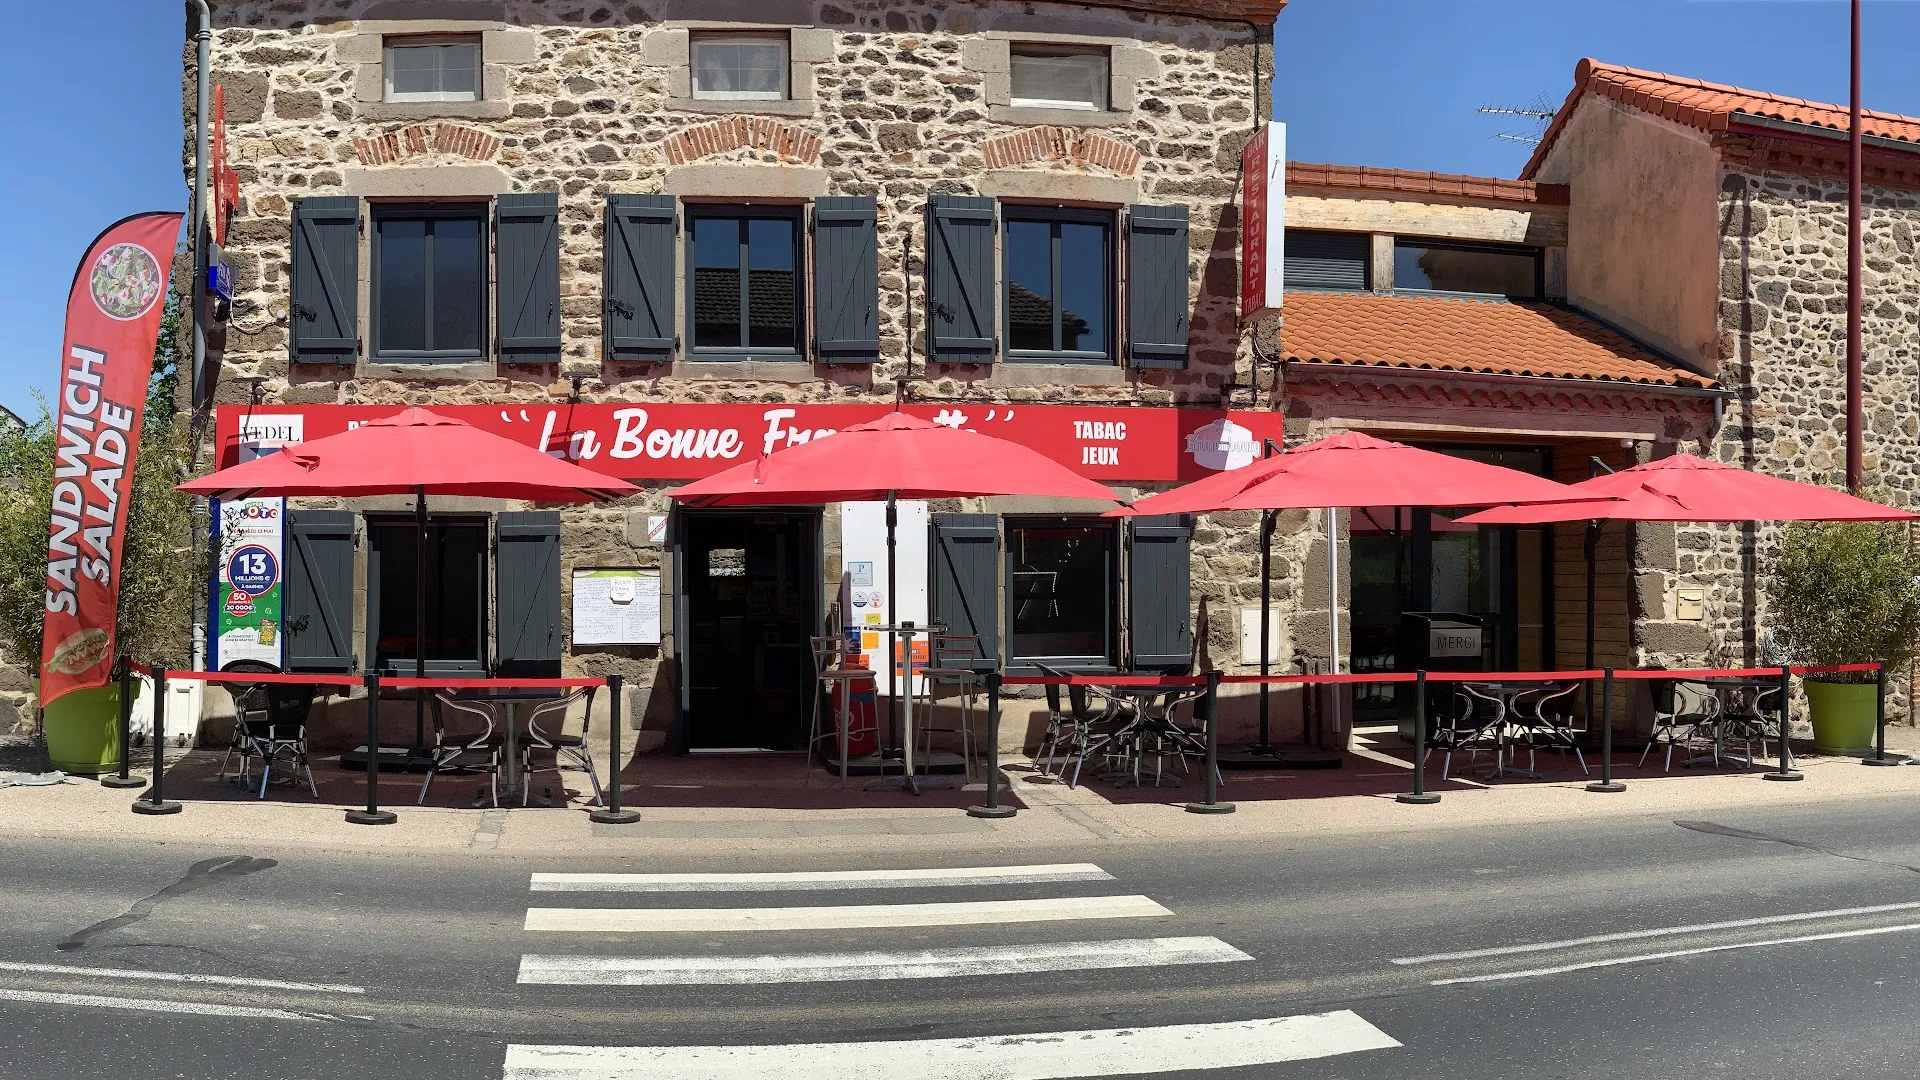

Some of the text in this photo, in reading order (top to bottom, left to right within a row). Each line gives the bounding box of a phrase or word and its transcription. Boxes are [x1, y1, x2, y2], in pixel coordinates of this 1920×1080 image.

[1247, 132, 1265, 158] BAR
[1249, 154, 1261, 290] RESTAURANT
[1244, 289, 1264, 315] TABAC
[242, 425, 300, 442] VEDEL
[609, 407, 744, 460] Bonne
[1073, 420, 1127, 441] TABAC
[1081, 446, 1119, 466] JEUX
[46, 344, 106, 617] SANDWICH
[81, 399, 133, 588] SALADE
[239, 553, 267, 575] 13
[233, 592, 247, 600] 50
[1437, 636, 1476, 650] MERCI
